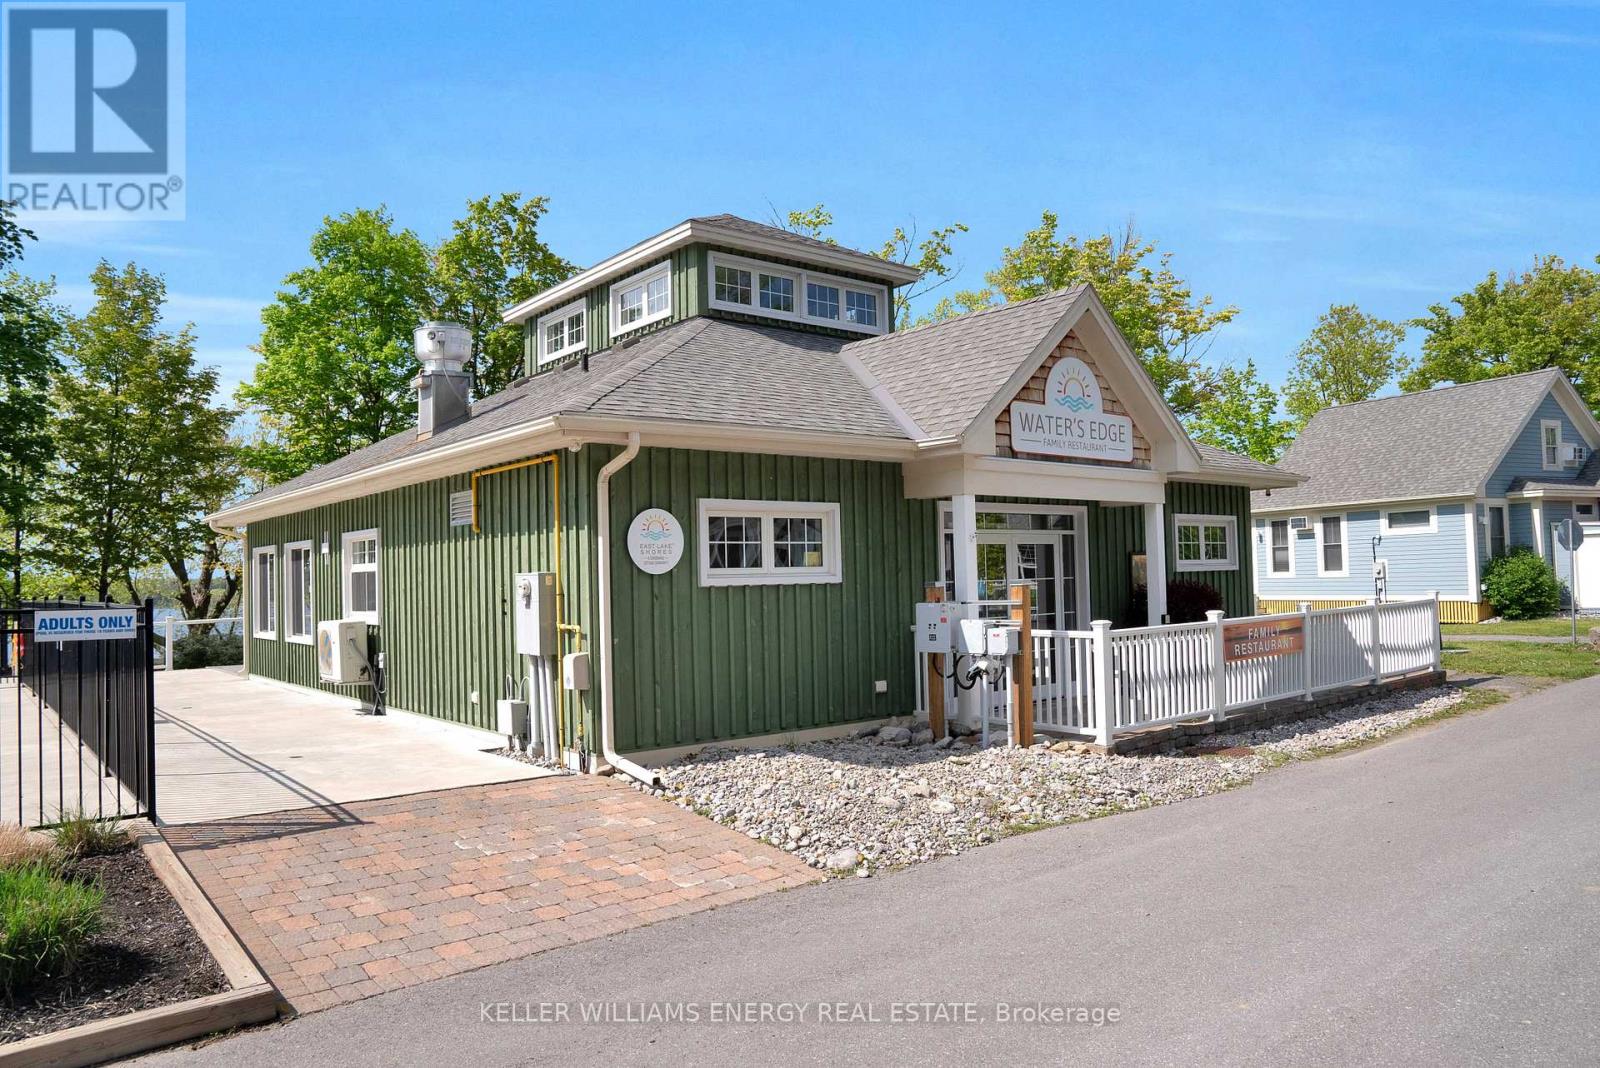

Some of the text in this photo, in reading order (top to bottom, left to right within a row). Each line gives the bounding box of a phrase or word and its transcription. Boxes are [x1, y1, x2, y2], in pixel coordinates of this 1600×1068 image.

[1019, 411, 1127, 443] WATER'S EDGE
[1043, 438, 1108, 453] FAMILY RESTAURANT
[38, 615, 133, 631] ADULTS ONLY
[1248, 625, 1280, 640] FAMILY
[1234, 636, 1295, 656] RESTAURANT
